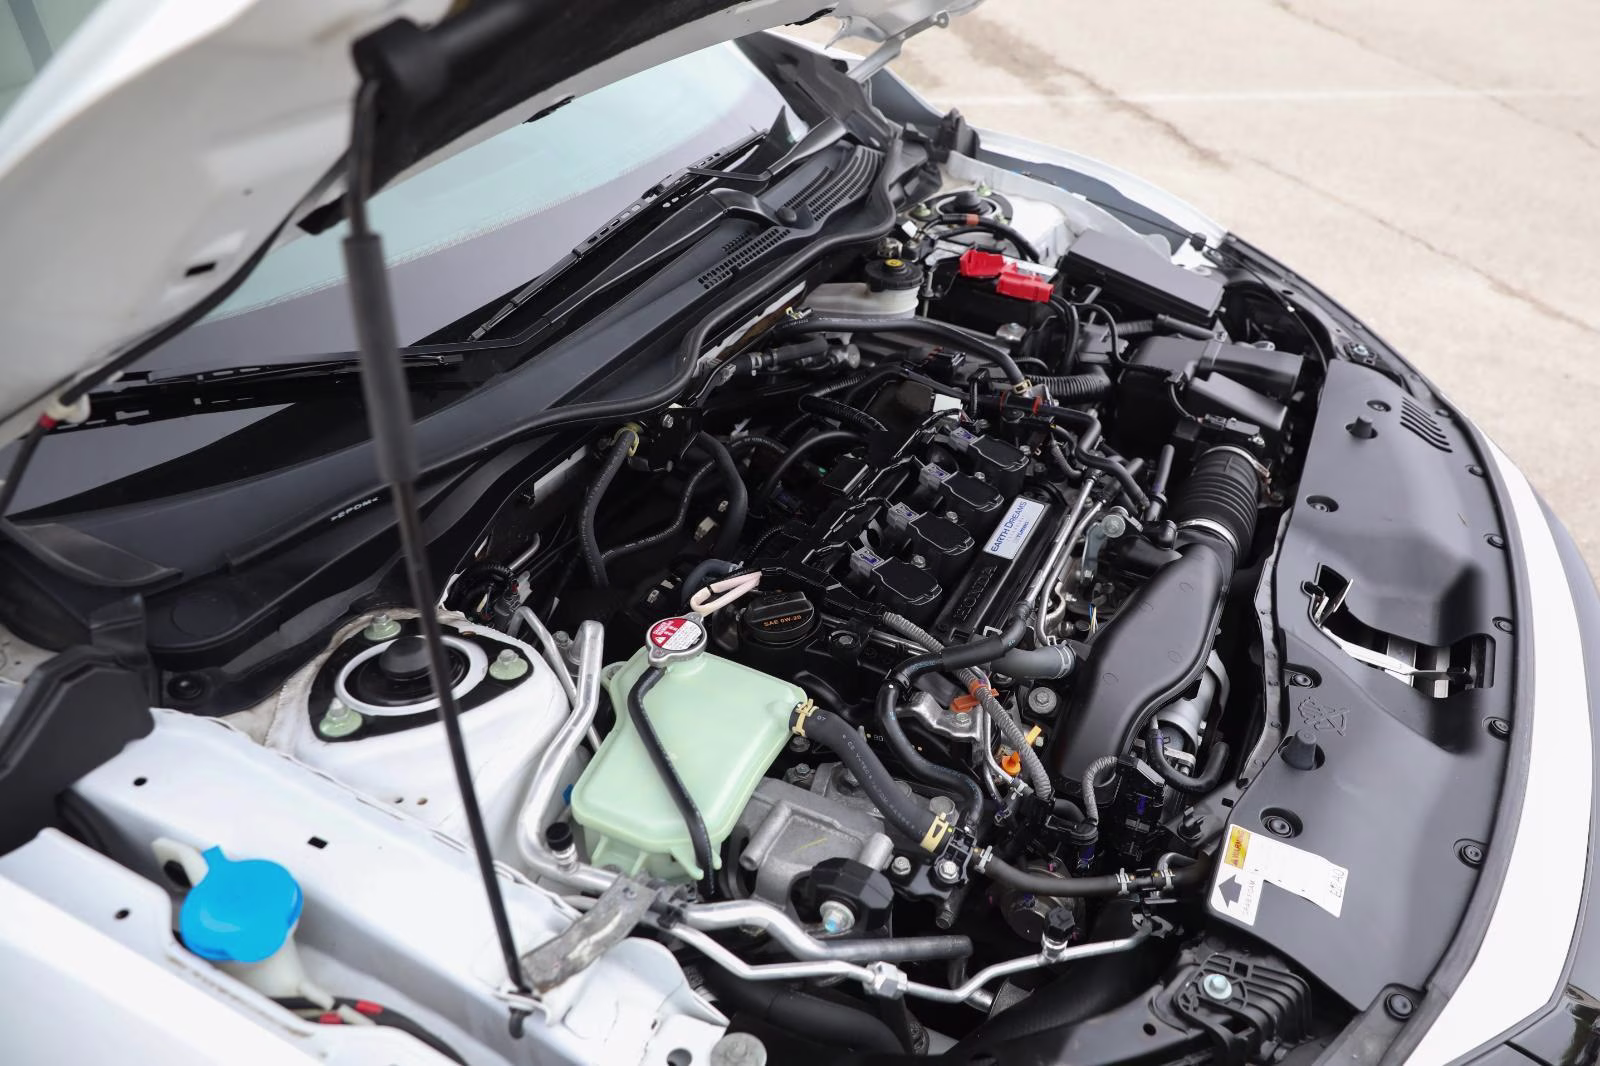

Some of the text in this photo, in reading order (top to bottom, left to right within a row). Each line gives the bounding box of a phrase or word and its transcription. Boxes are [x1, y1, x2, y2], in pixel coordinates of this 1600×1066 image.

[991, 526, 1010, 552] EARTH
[1004, 501, 1027, 529] DREAMS
[763, 618, 779, 628] SAE
